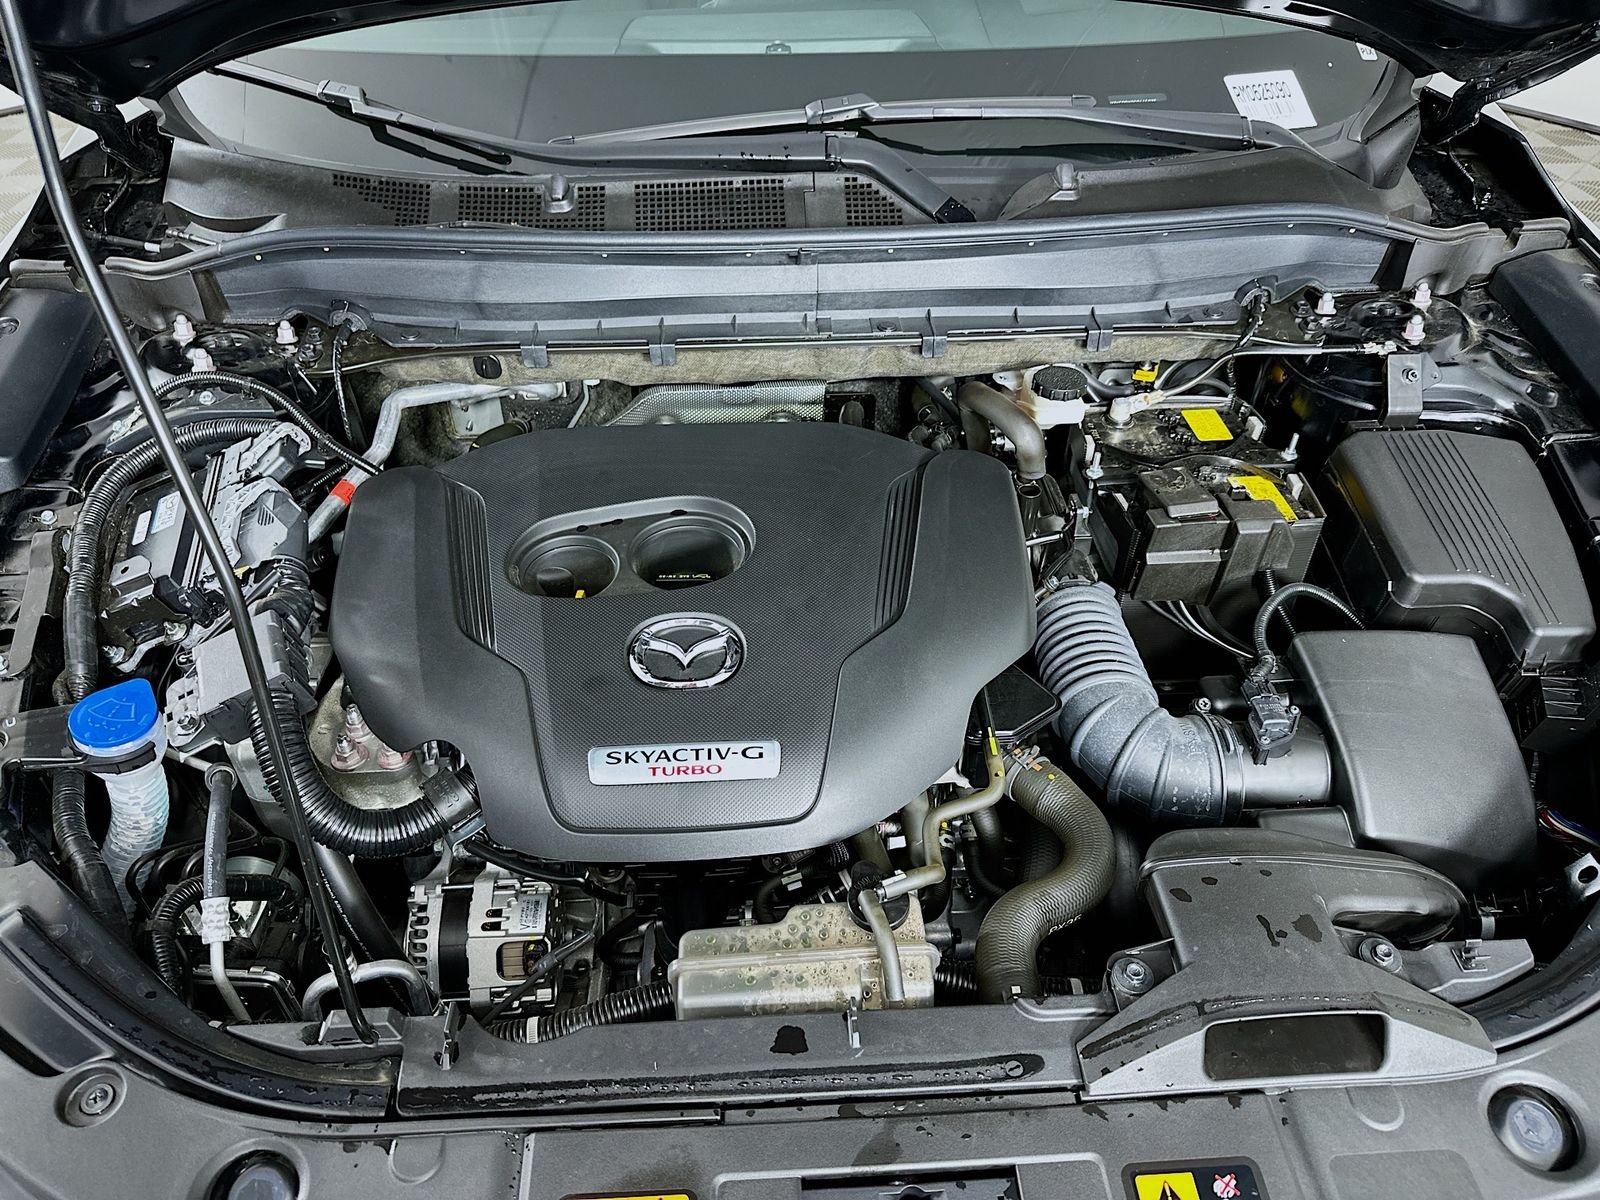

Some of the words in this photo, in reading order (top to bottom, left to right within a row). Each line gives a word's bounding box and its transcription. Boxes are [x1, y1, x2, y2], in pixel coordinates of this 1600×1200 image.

[1232, 81, 1291, 102] RM0625090
[605, 746, 764, 765] SKYACTIV-G
[648, 764, 722, 776] TURBO
